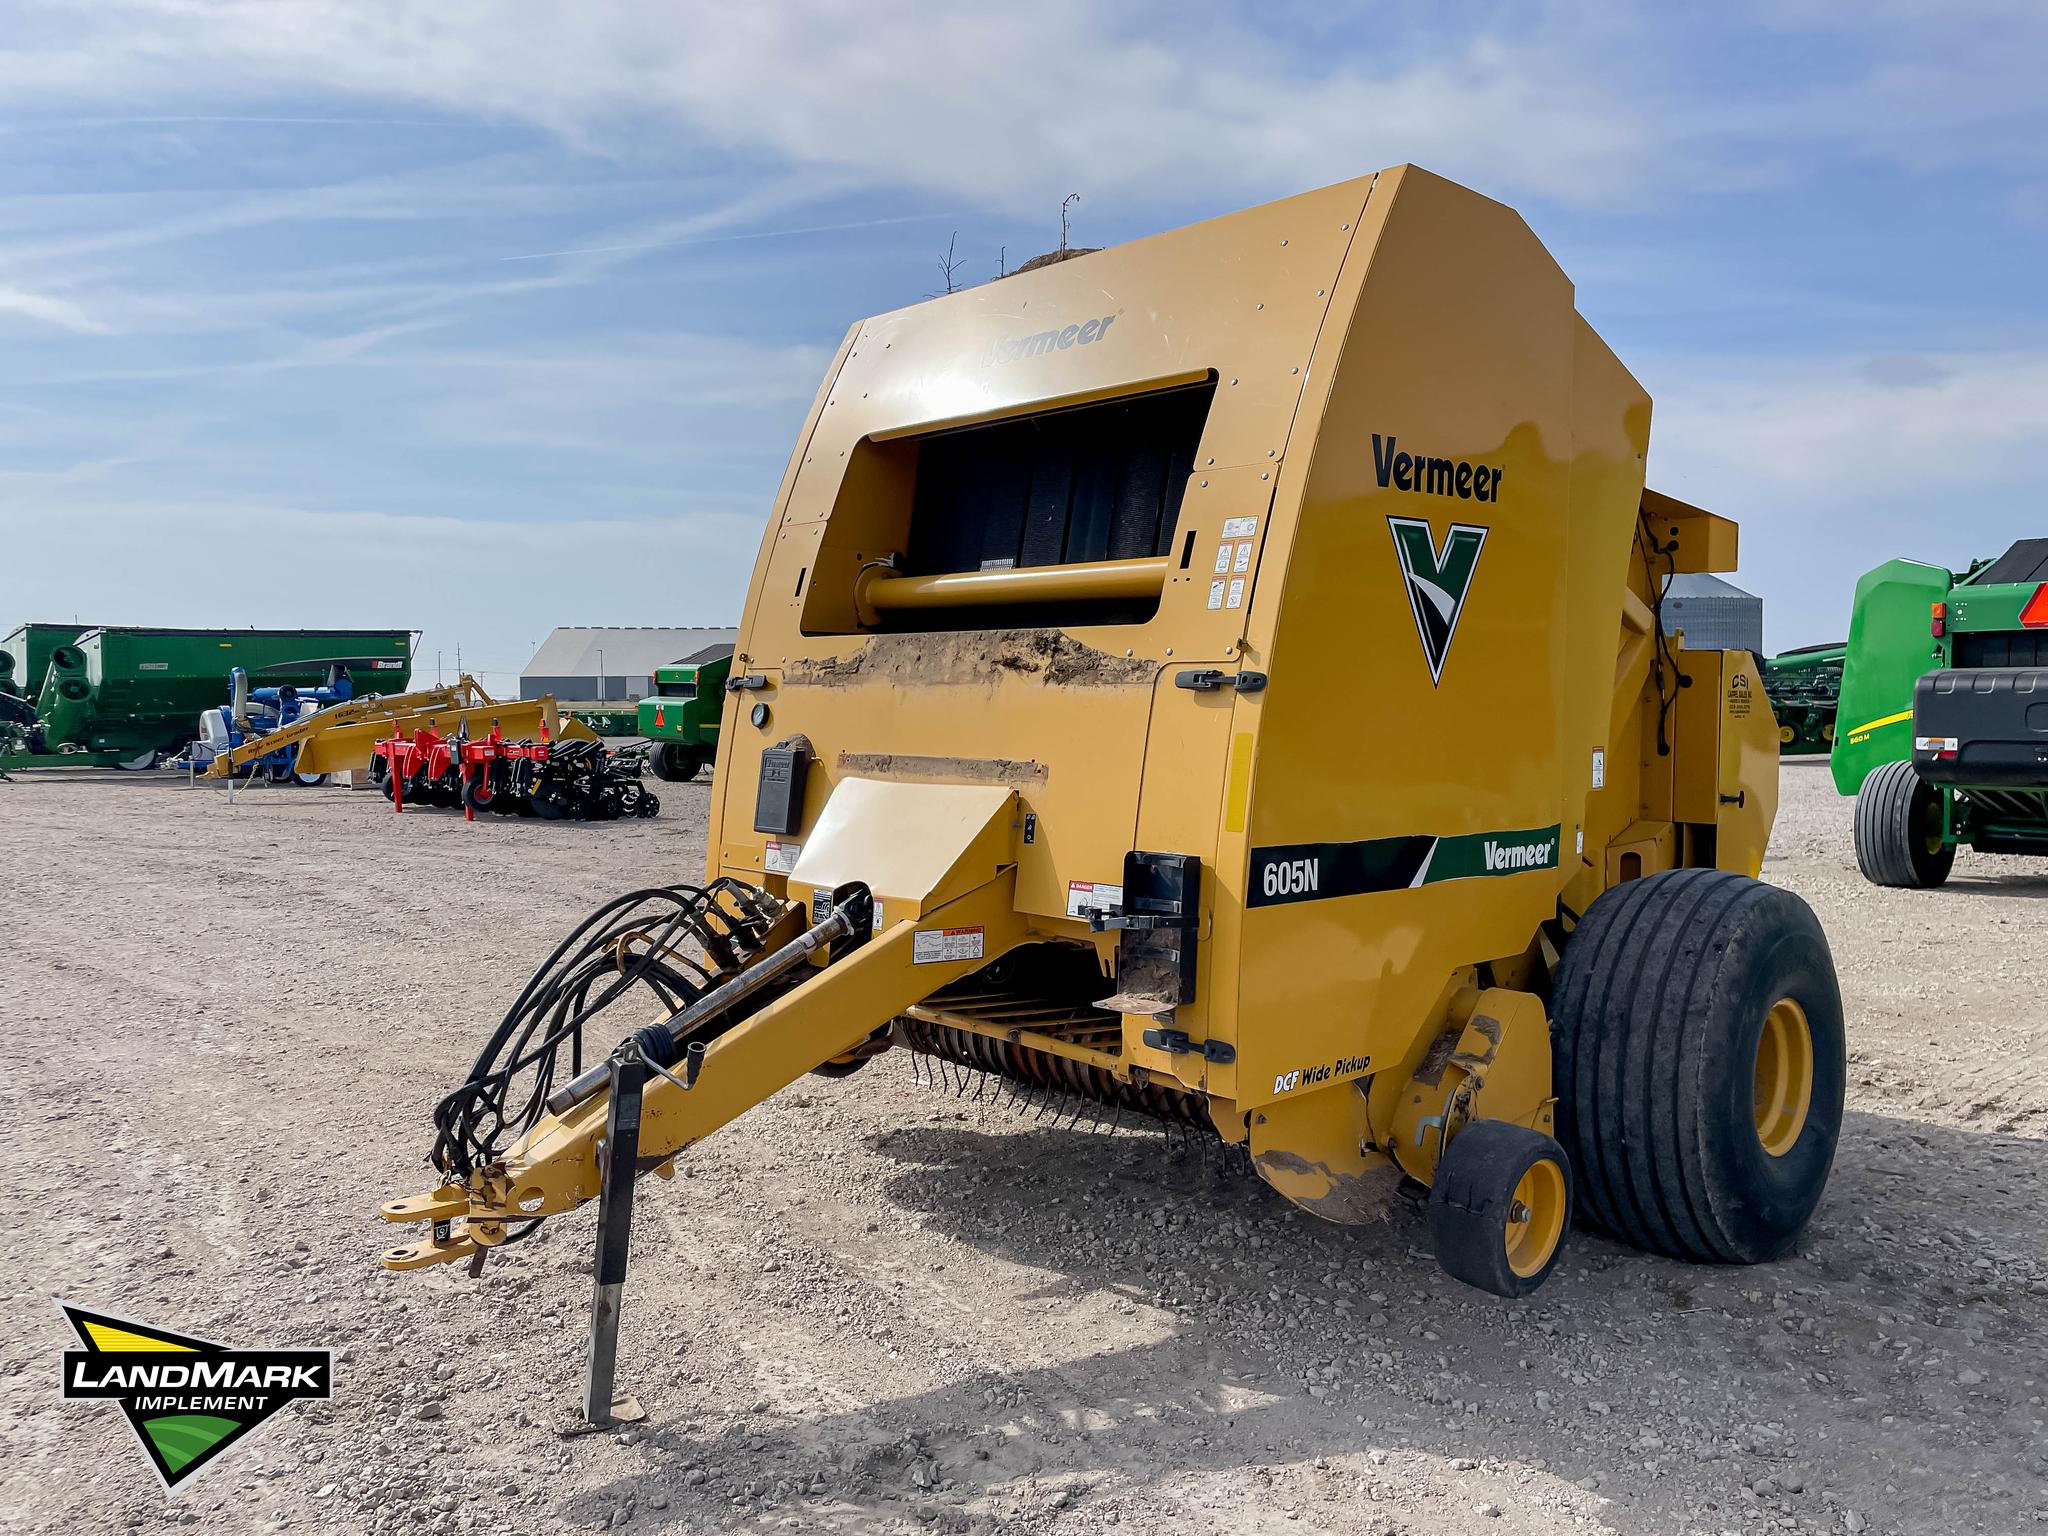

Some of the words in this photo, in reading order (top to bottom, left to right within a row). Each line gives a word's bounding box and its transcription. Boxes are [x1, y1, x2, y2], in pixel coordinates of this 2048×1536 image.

[981, 314, 1117, 367] Vermeer
[1371, 433, 1502, 503] Vermeer
[377, 660, 403, 669] Brandt
[1732, 674, 1749, 690] CSI
[1263, 859, 1319, 897] 605N
[1484, 840, 1551, 871] Vermeer
[1273, 1070, 1300, 1095] DCF
[1301, 1064, 1332, 1086] Wide
[1334, 1056, 1371, 1078] Pickup
